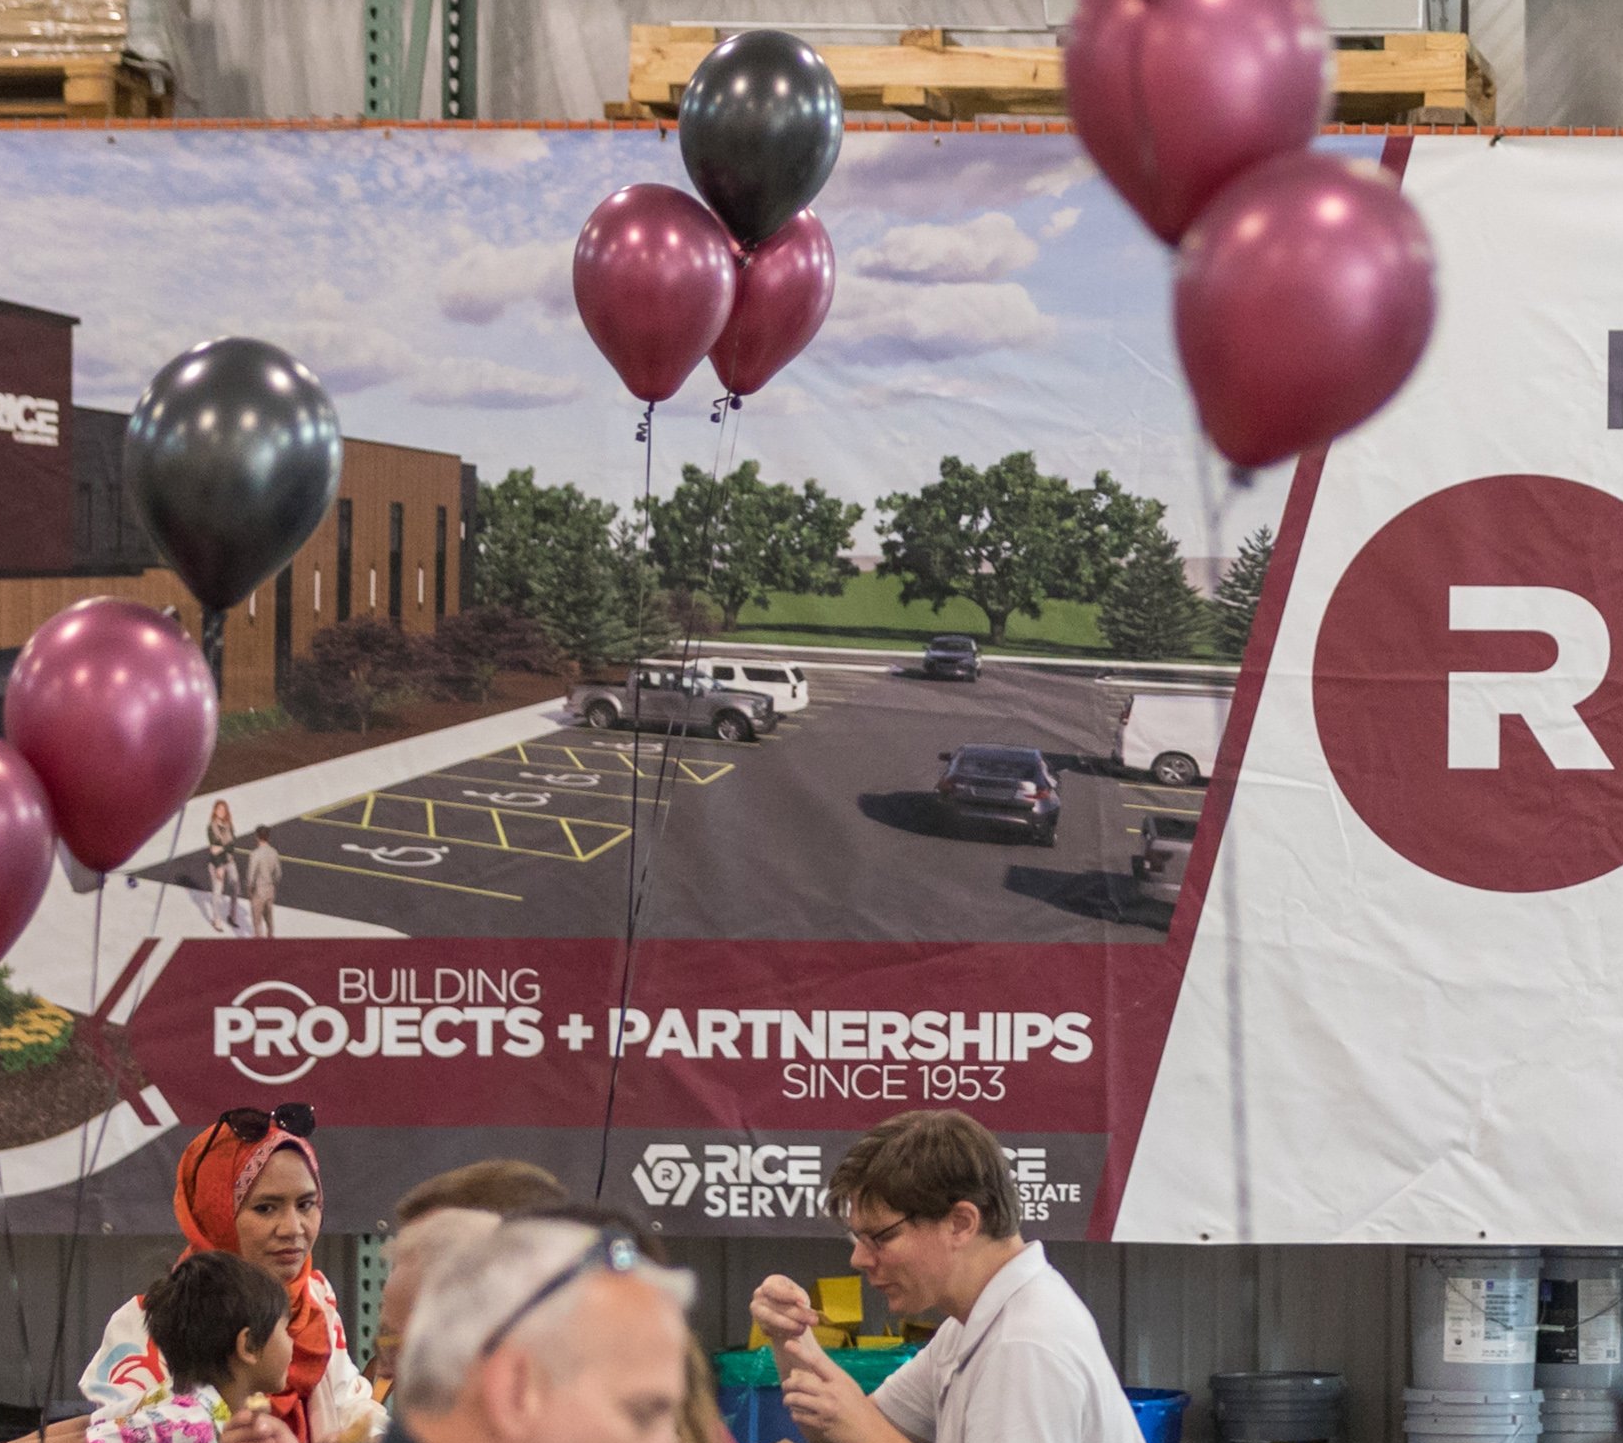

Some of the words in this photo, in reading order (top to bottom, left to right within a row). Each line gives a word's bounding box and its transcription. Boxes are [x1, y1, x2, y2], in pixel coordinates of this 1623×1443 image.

[1446, 584, 1614, 771] R
[337, 967, 542, 1005] BUILDING
[213, 1005, 545, 1059] PROJECTS
[608, 1007, 1094, 1063] PARTNERSHIPS
[782, 1063, 908, 1100] SINCE
[918, 1064, 1007, 1102] 1953
[704, 1144, 822, 1185] RICE
[704, 1184, 851, 1218] SERVI
[1015, 1183, 1081, 1202] STATE
